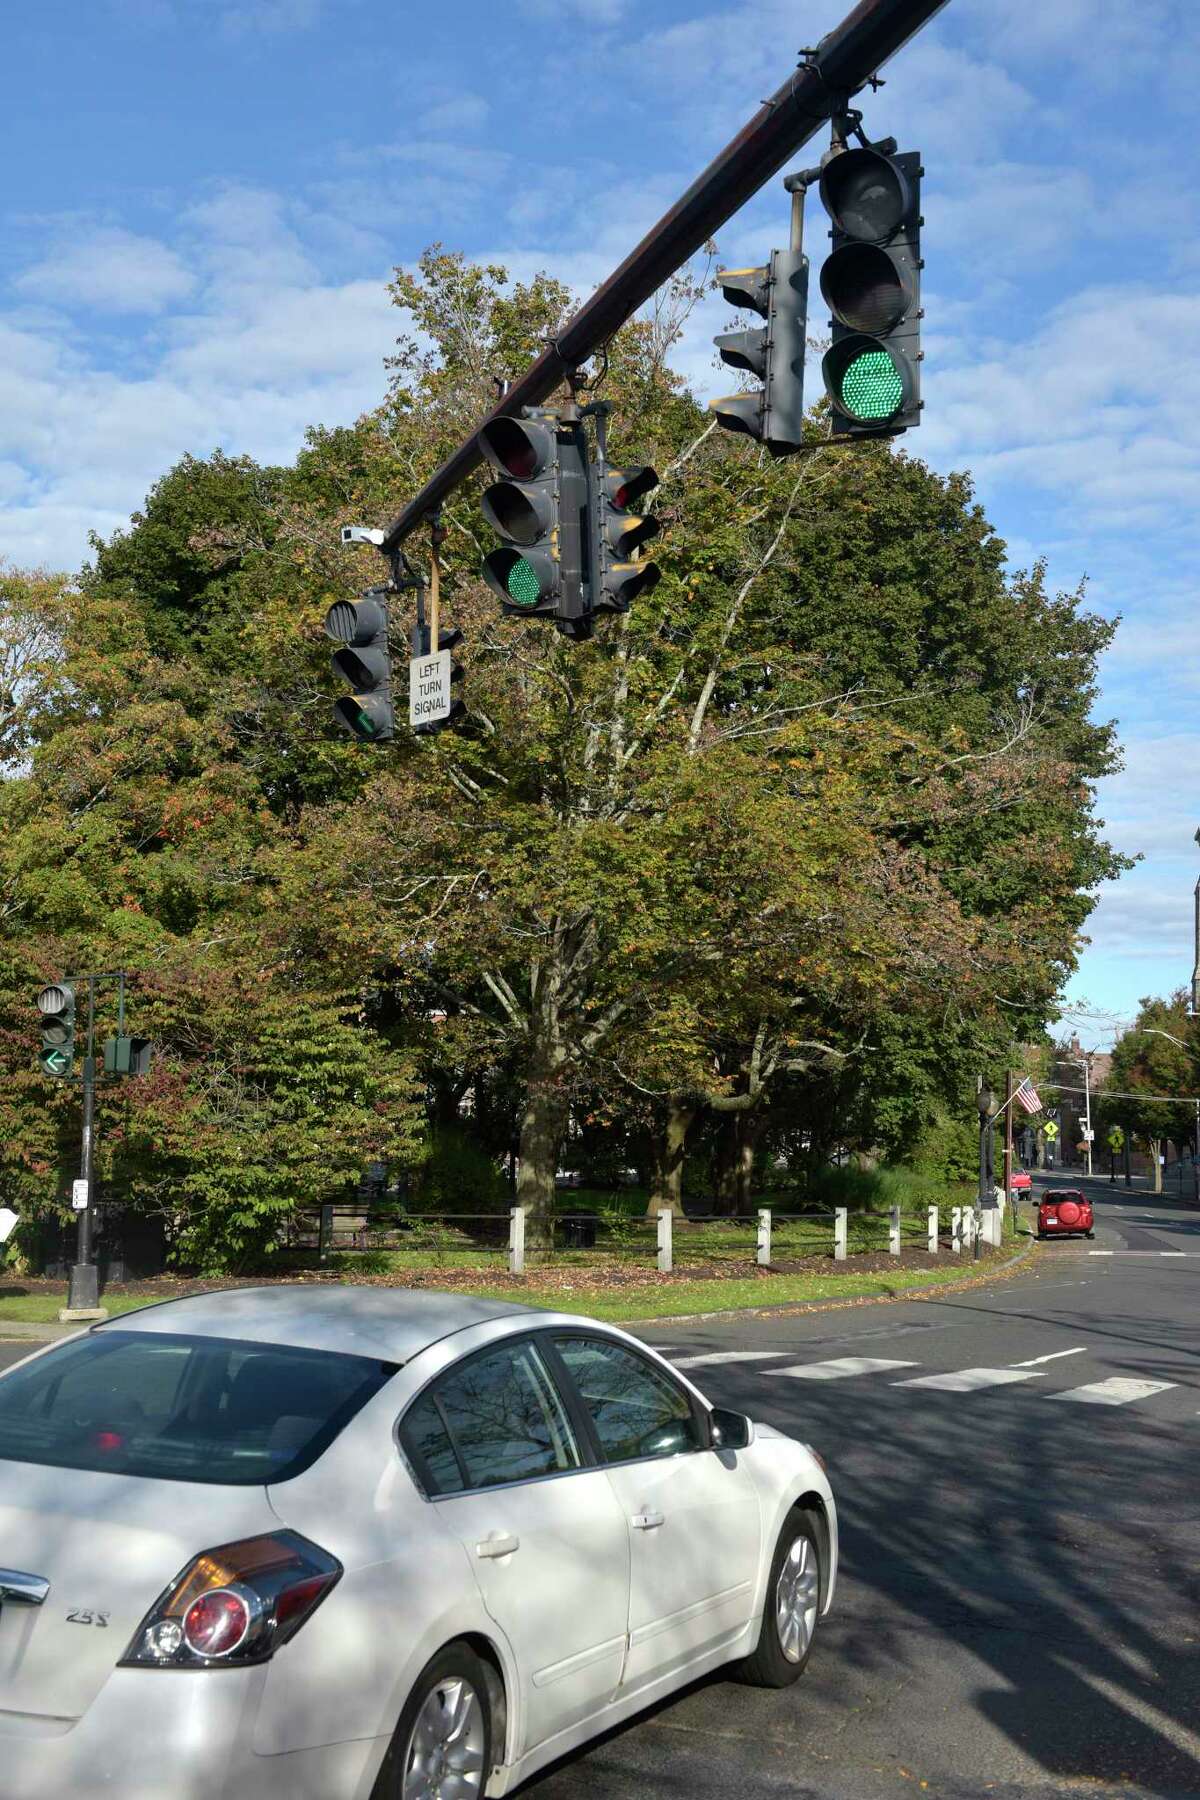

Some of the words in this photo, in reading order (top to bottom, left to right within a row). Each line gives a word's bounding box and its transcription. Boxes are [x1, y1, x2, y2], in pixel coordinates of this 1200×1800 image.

[419, 662, 441, 679] LEFT
[418, 679, 442, 697] TURN
[414, 696, 447, 716] SIGNAL
